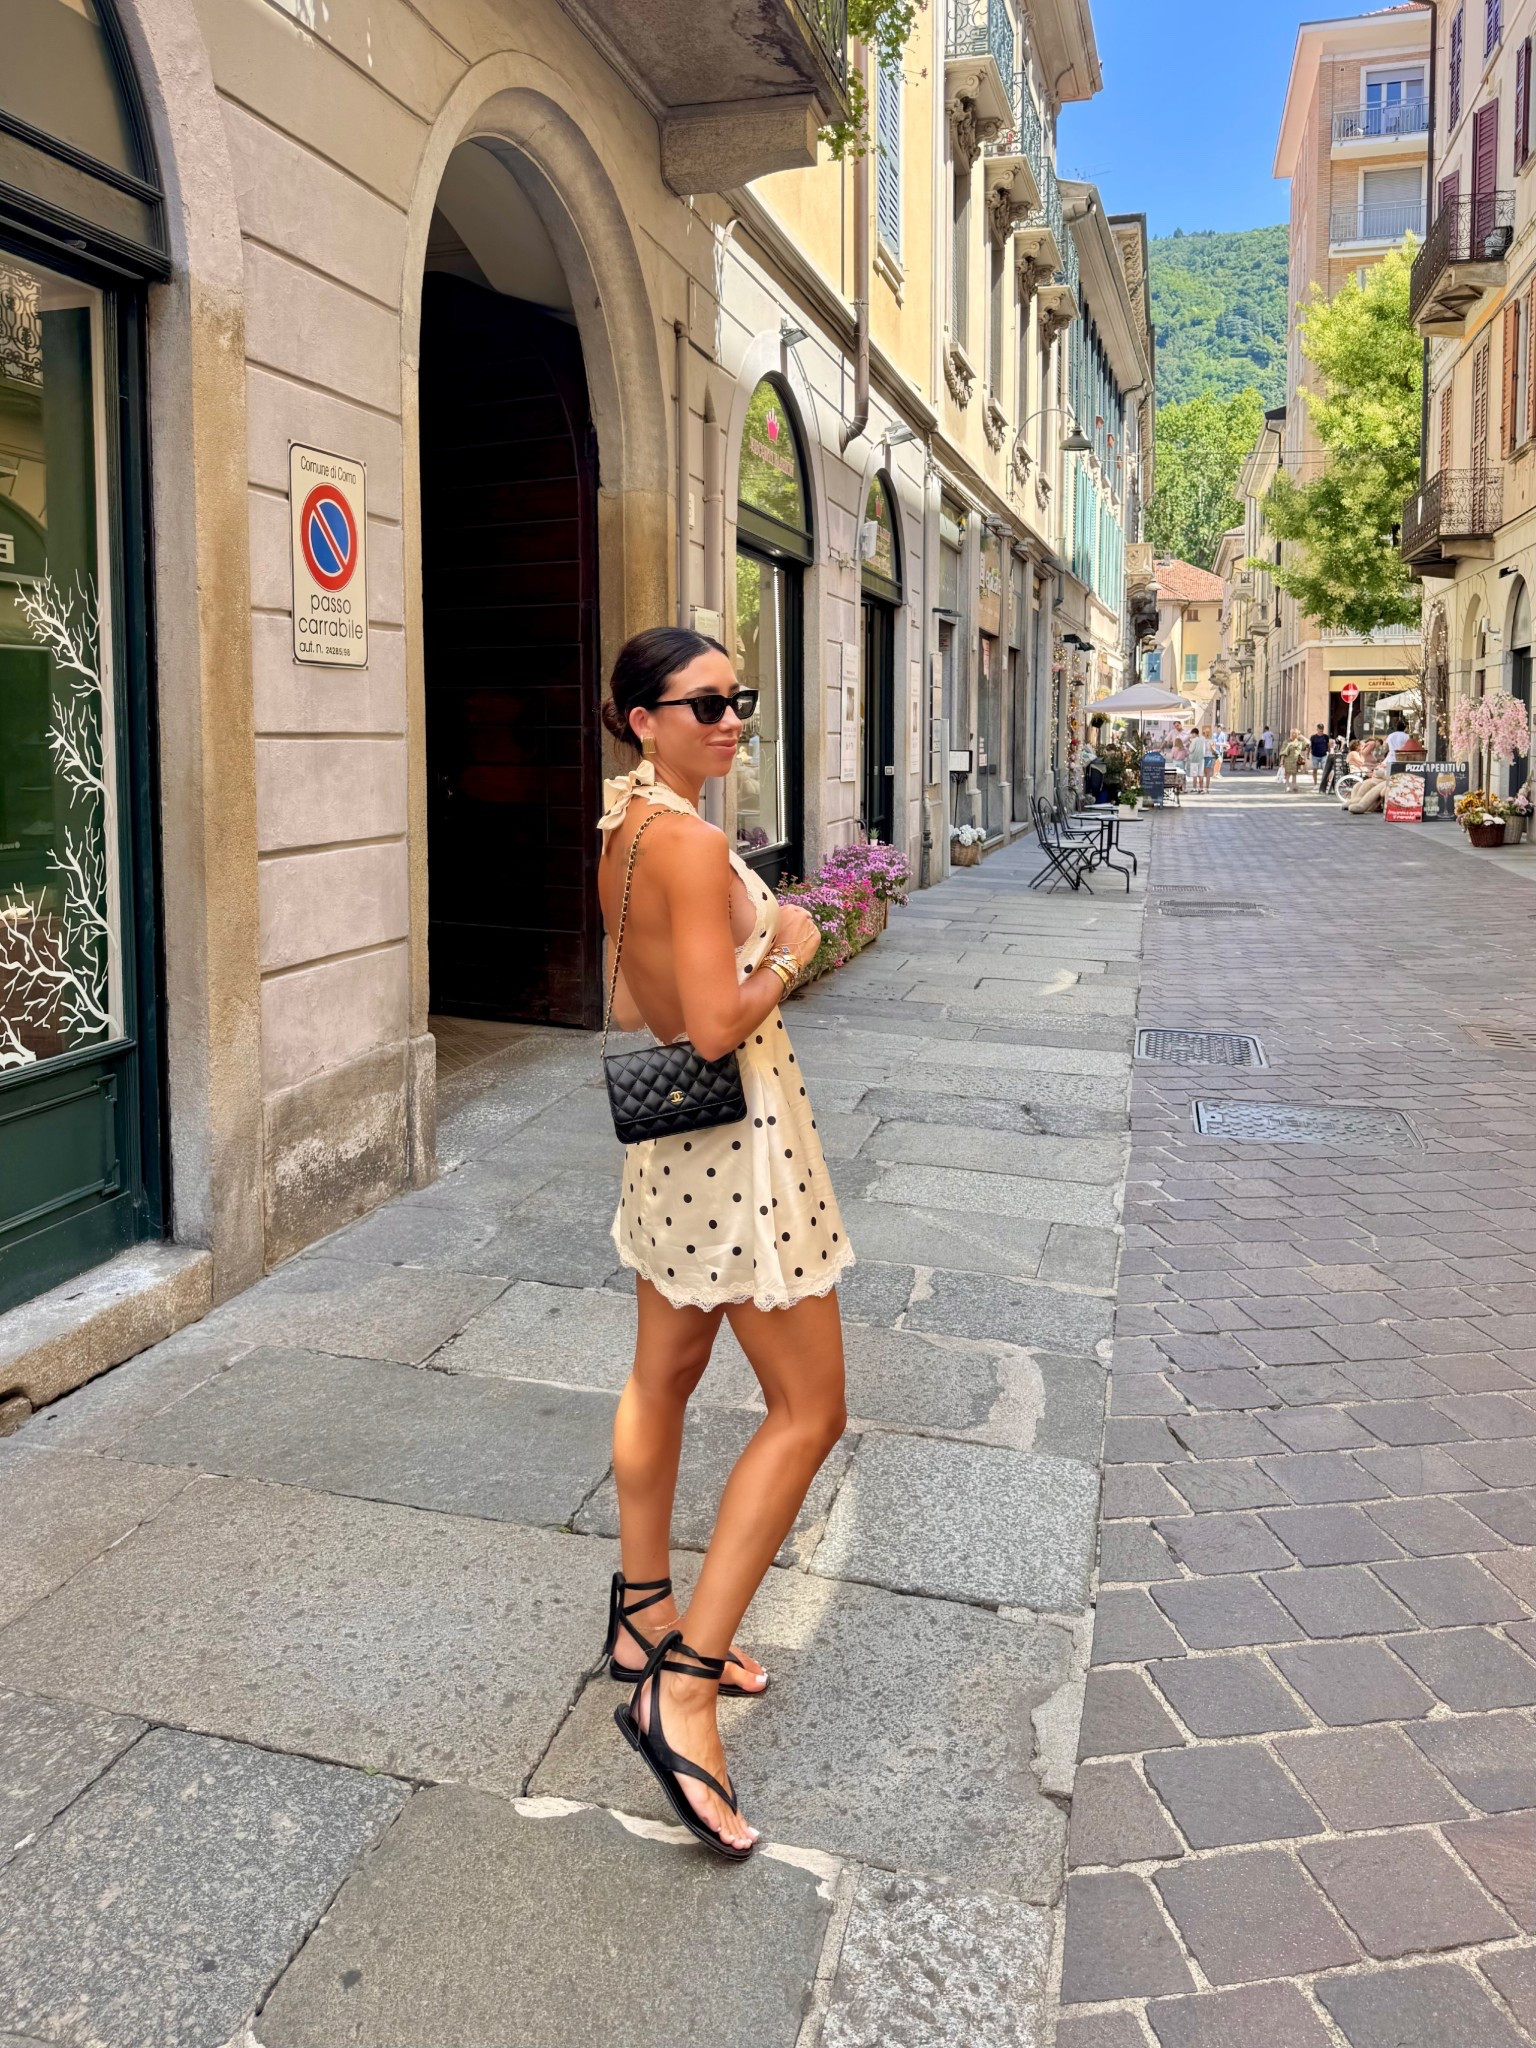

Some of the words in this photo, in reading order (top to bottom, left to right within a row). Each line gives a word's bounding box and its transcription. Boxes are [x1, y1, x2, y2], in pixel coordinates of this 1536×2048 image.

[301, 455, 329, 477] Comune
[330, 465, 337, 479] di
[338, 466, 356, 485] Como
[311, 594, 351, 615] passo
[299, 617, 363, 640] carrabile
[1405, 763, 1425, 772] PIZZA
[1426, 763, 1466, 773] APERITIVO
